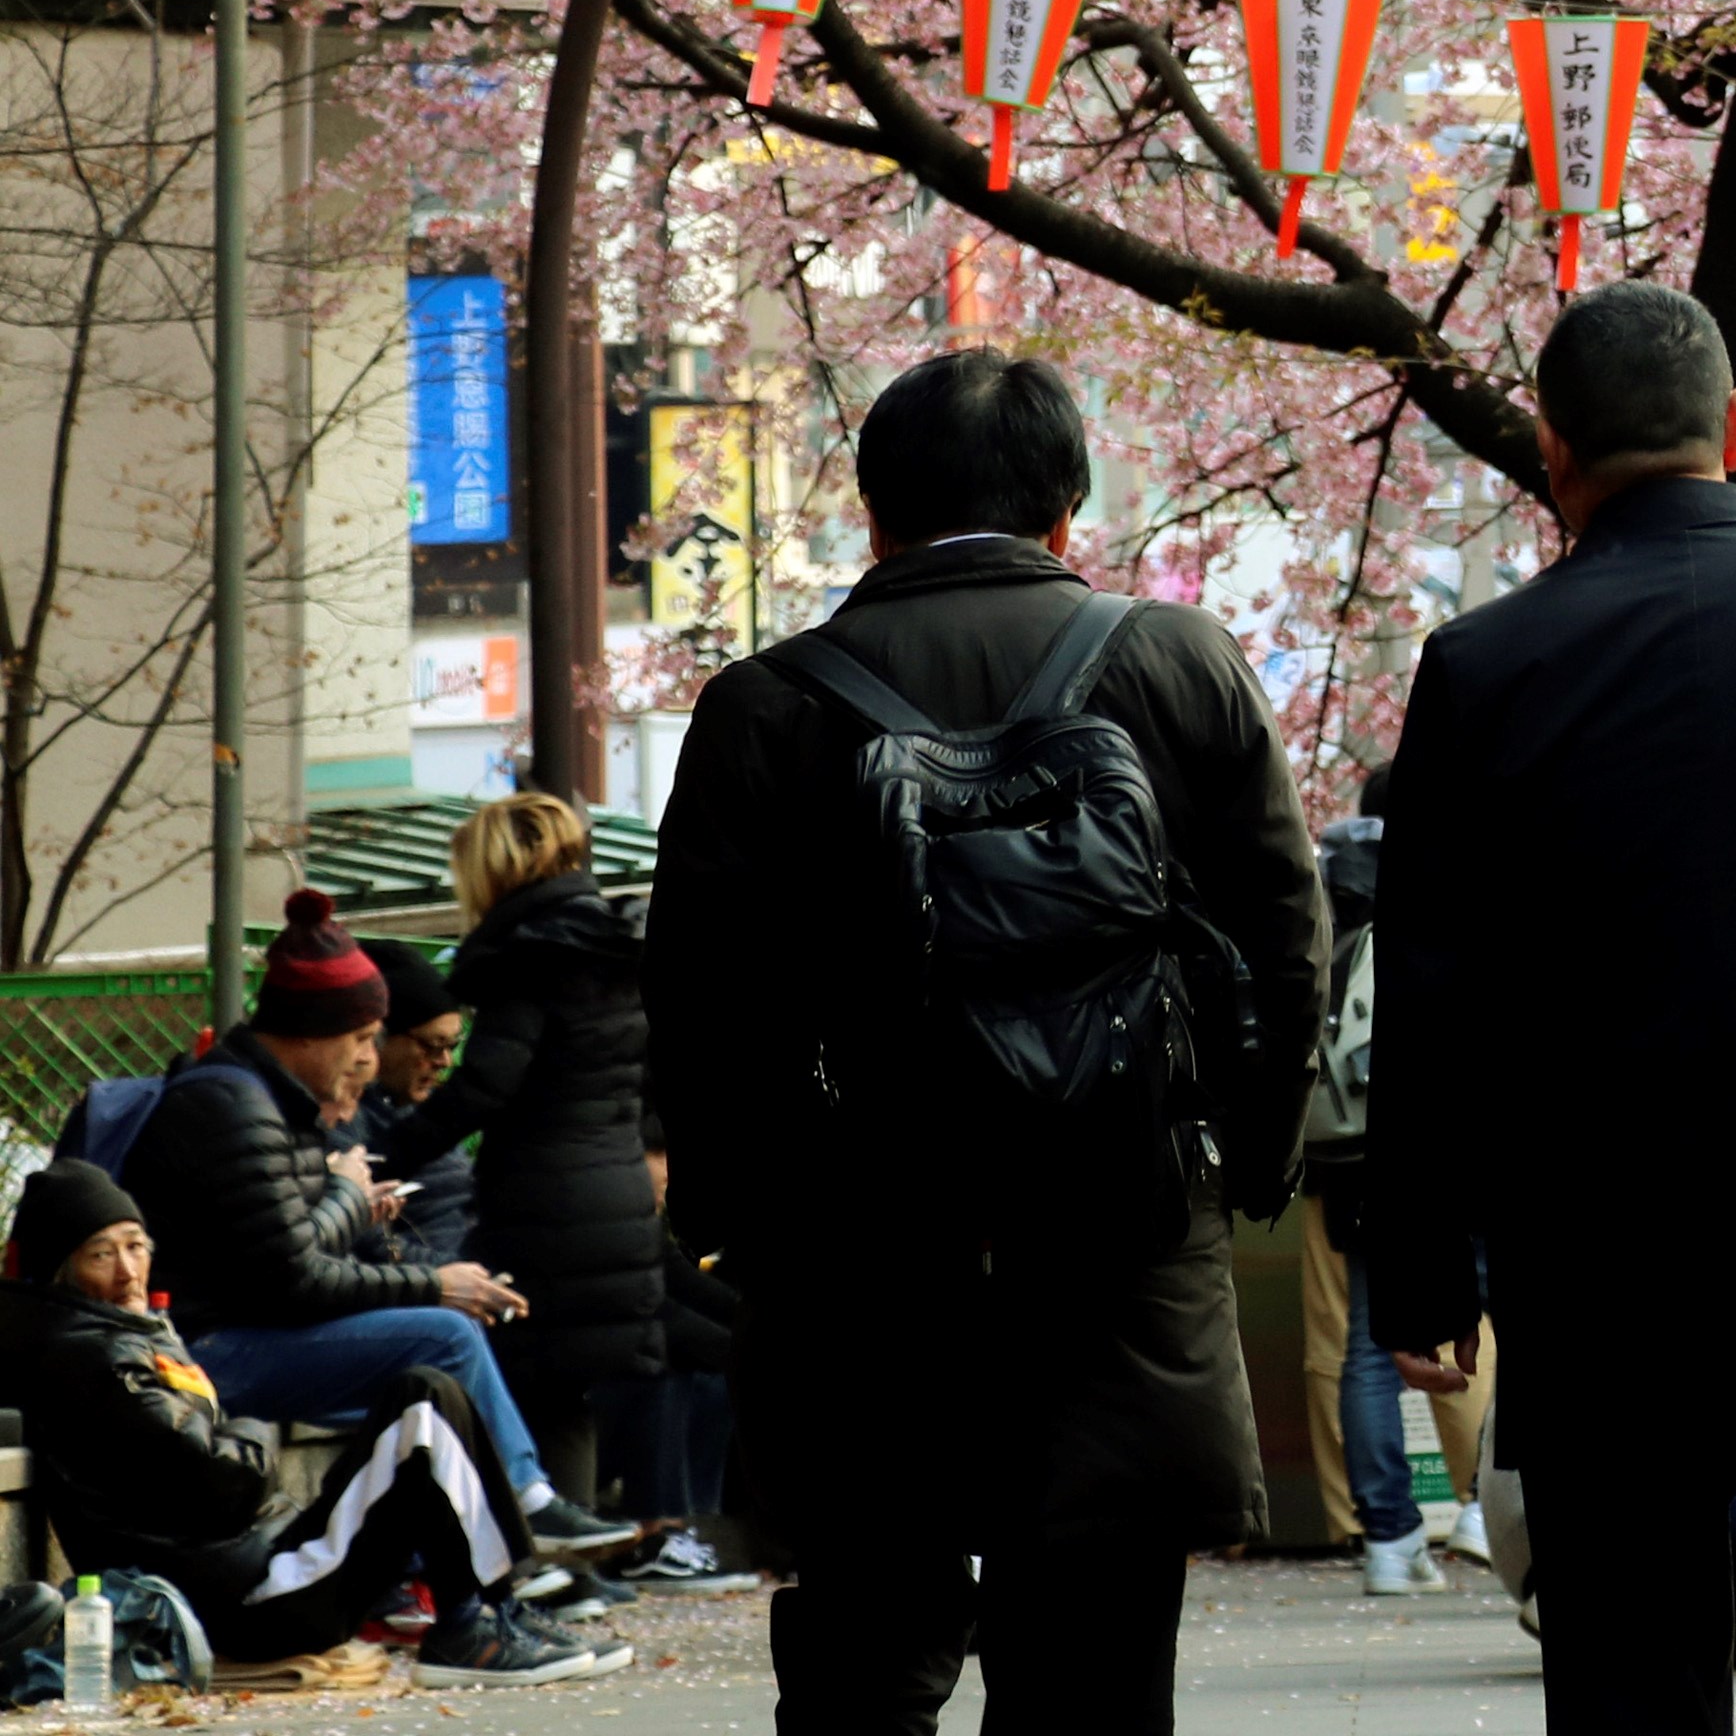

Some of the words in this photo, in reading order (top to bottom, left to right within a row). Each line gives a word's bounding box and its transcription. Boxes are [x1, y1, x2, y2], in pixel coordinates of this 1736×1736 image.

[1560, 32, 1600, 190] 上野郵便局
[452, 290, 492, 530] 上野恩賜公園
